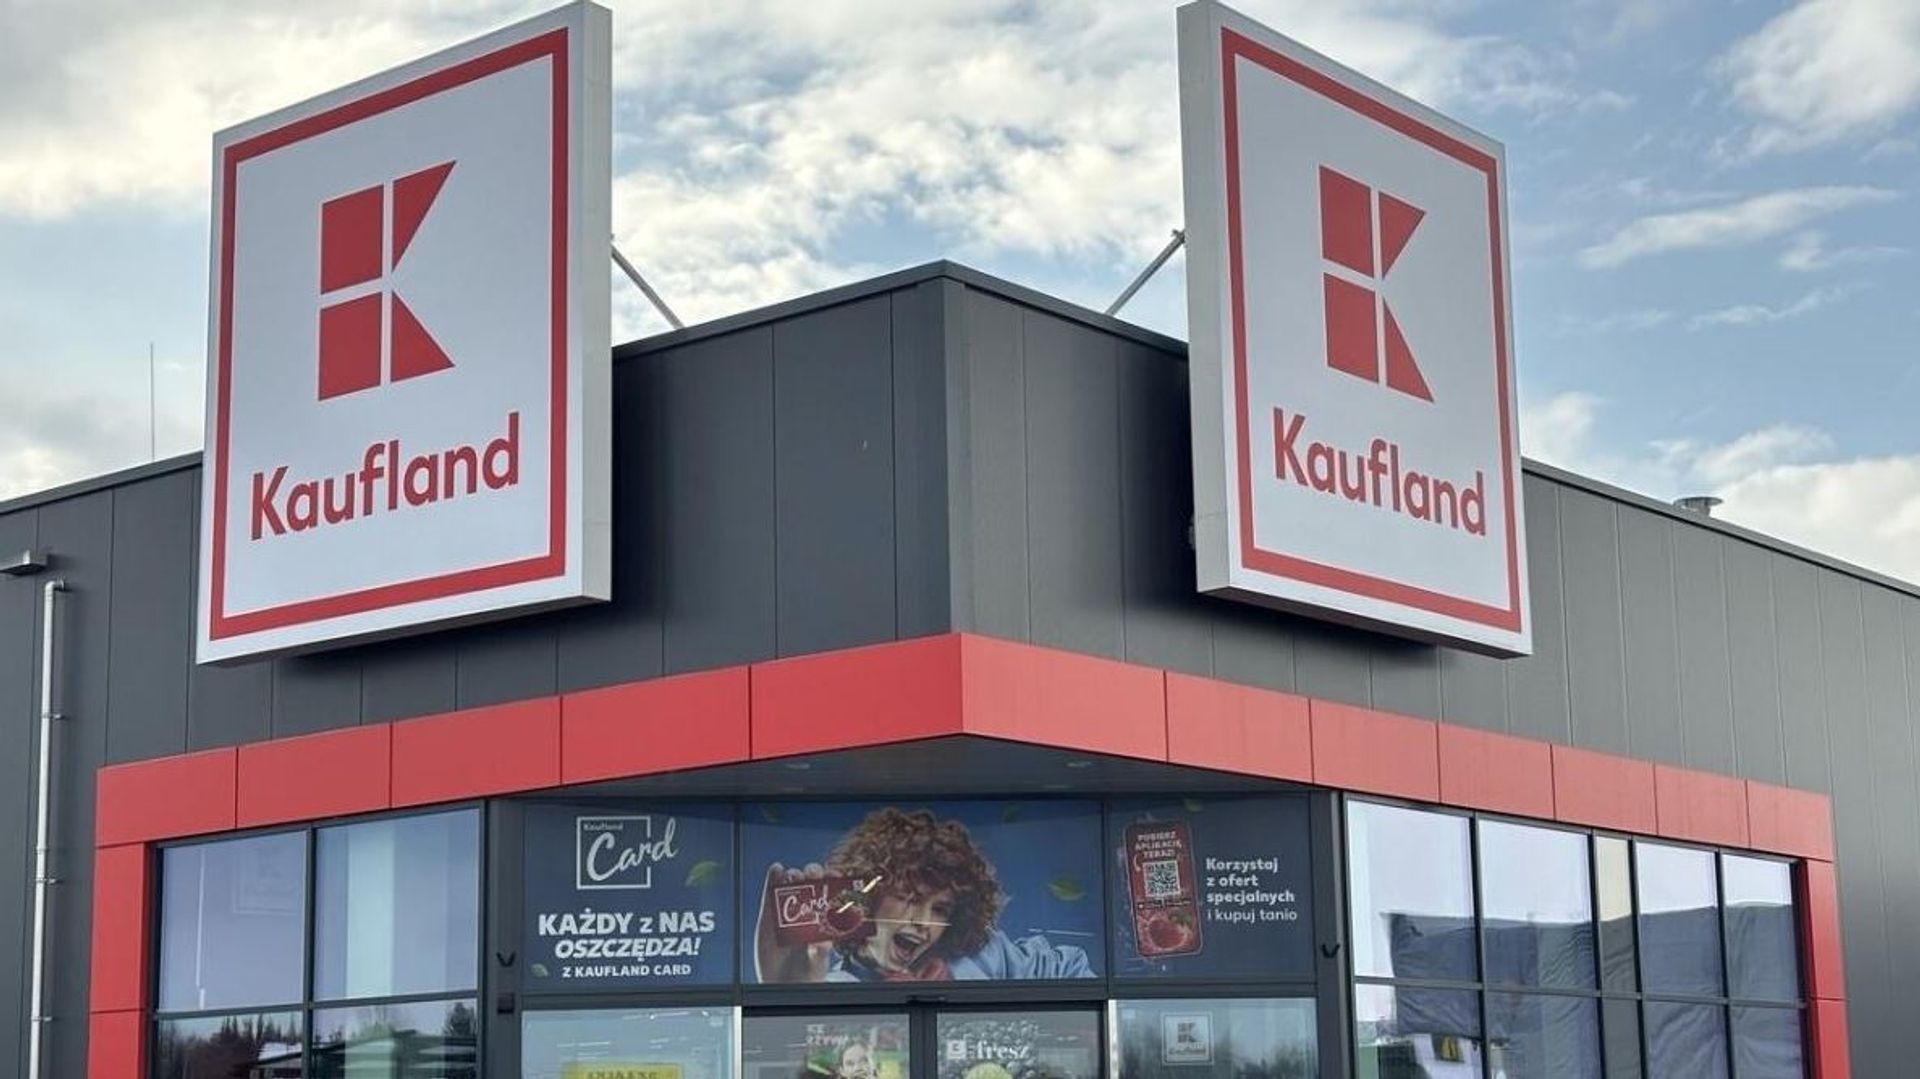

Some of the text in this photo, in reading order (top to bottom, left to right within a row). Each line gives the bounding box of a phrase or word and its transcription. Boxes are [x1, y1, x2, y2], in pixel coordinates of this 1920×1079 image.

[251, 411, 519, 541] Kaufland
[1272, 406, 1487, 536] Kaufland
[586, 816, 679, 882] Card
[1206, 857, 1278, 874] Korzystaj
[1206, 873, 1259, 887] z ofert
[783, 884, 830, 922] Card
[1206, 889, 1295, 906] specjalnych
[538, 907, 716, 936] KAŻDY z NAS
[1215, 908, 1255, 924] kupuj
[1259, 908, 1298, 921] tanio
[554, 937, 702, 962] OSZCZĘDZA!
[562, 963, 692, 978] Z KAUFLAND CARD
